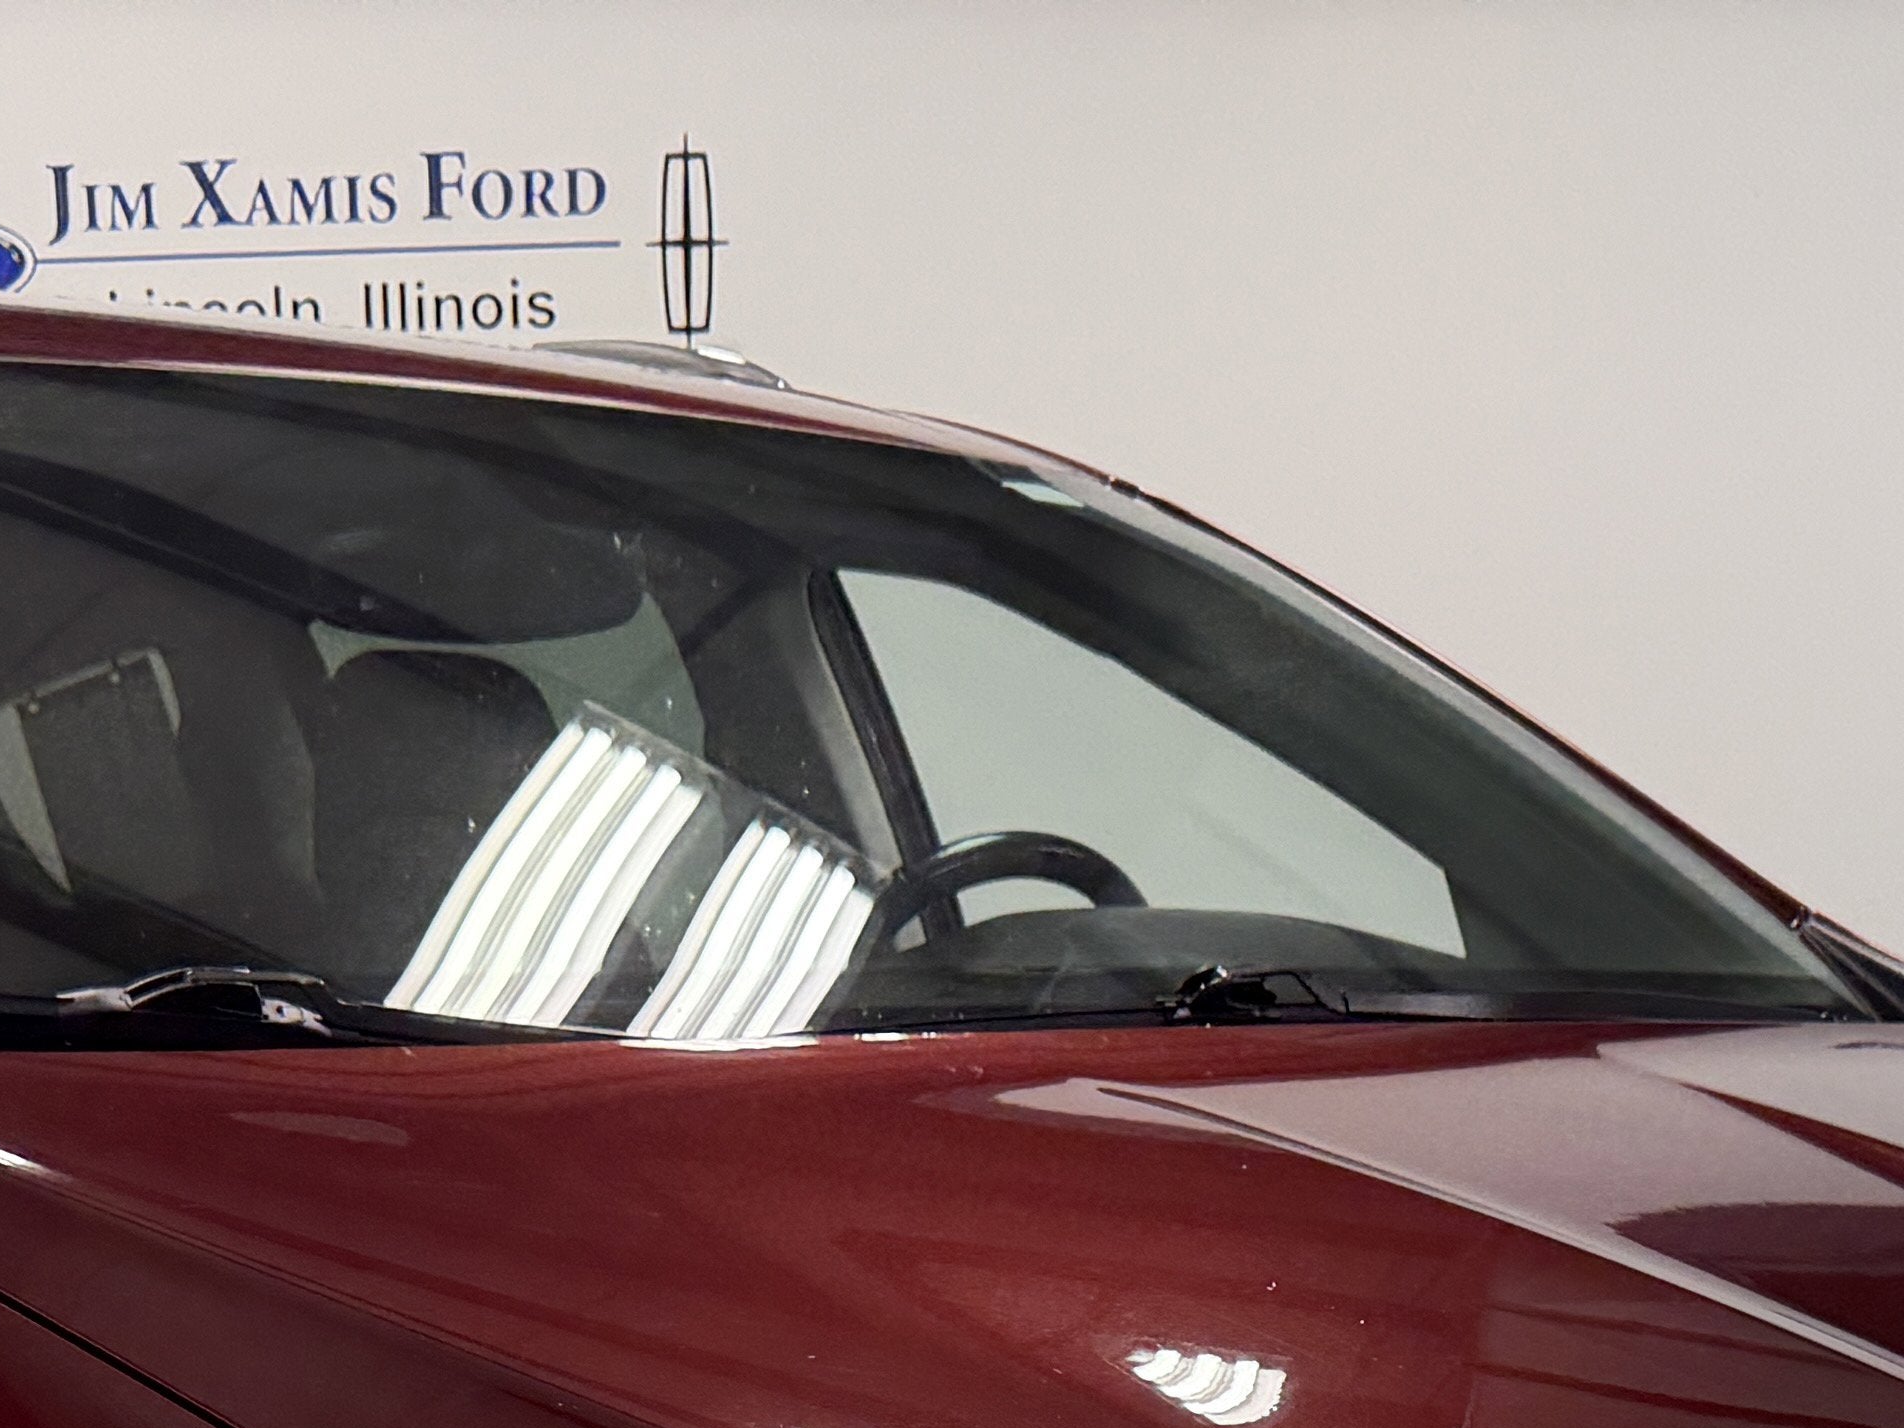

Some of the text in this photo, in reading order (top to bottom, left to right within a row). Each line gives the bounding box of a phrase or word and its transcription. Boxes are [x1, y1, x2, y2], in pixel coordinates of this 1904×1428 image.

[47, 151, 608, 246] JIM XAMIS FORD
[363, 276, 557, 331] Illinois
